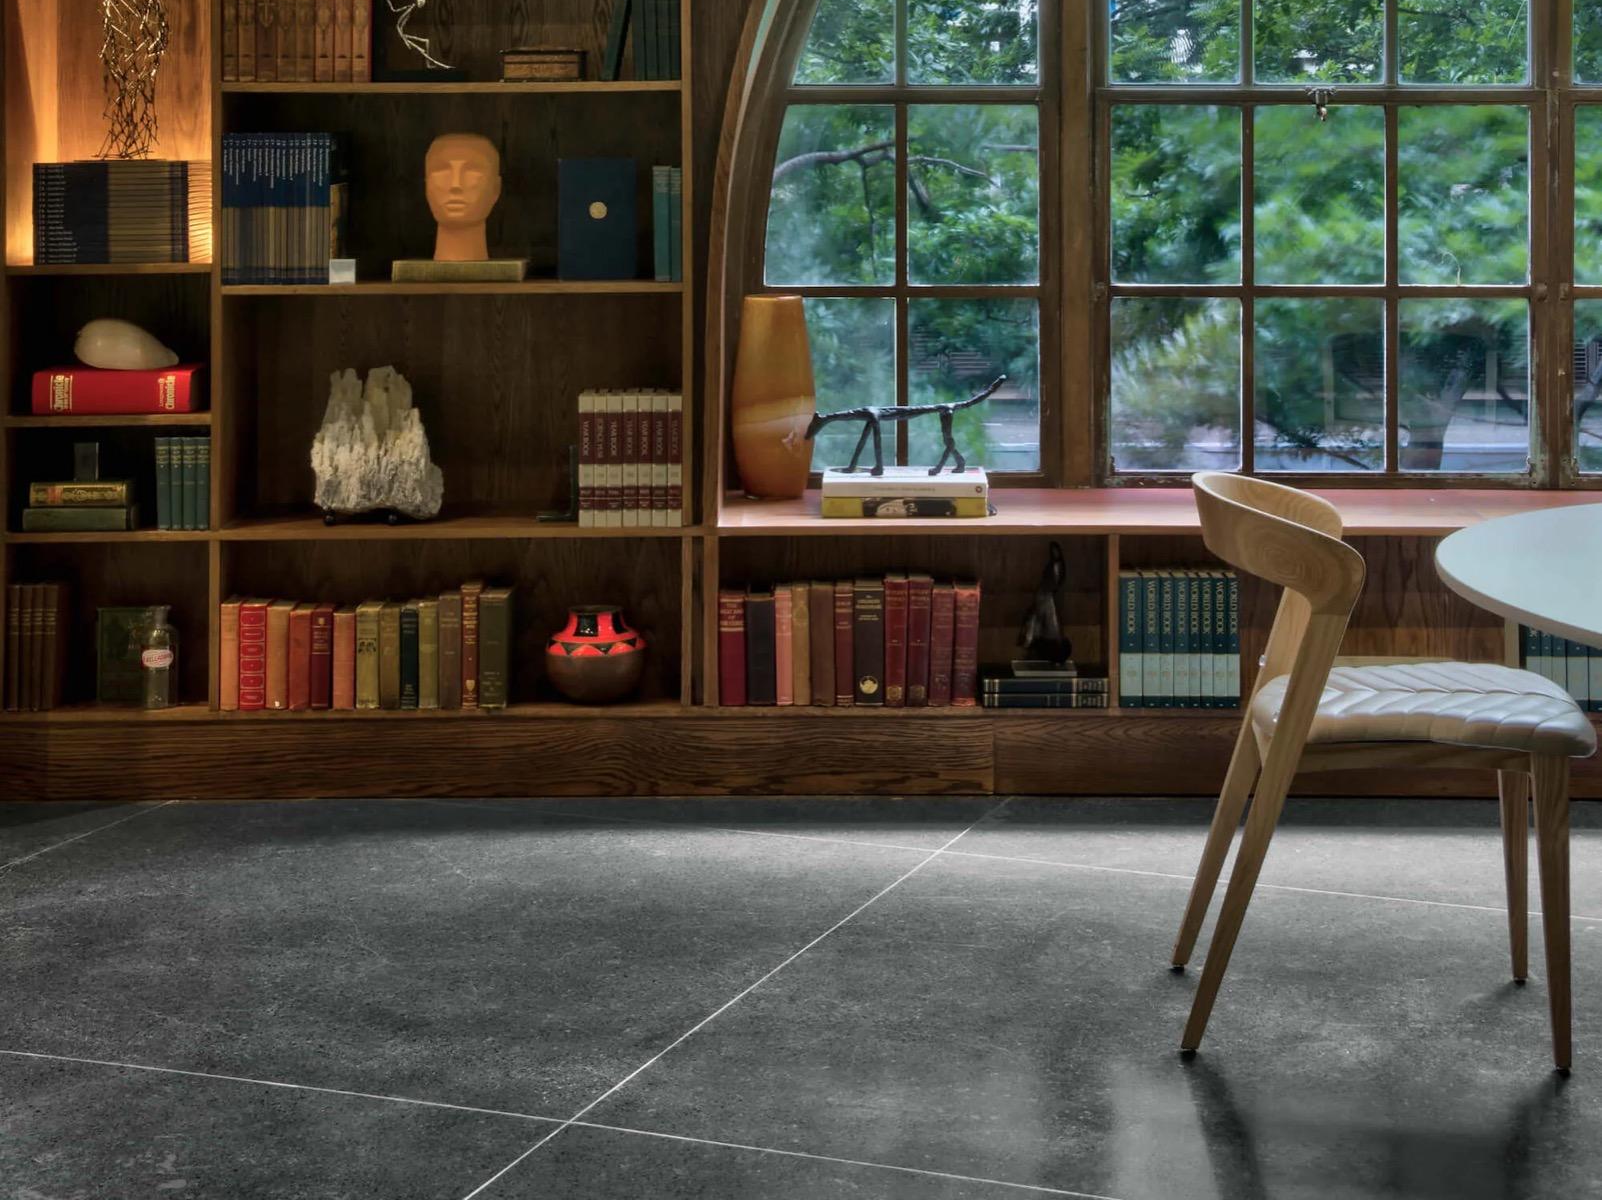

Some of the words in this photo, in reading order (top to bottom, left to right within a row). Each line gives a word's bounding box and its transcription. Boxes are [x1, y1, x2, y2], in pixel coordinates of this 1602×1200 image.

[54, 375, 65, 411] Chronicle
[166, 375, 176, 410] Chronicle
[582, 437, 590, 456] BOOK
[1128, 580, 1136, 610] WORLD
[1148, 580, 1156, 610] WORLD
[1163, 580, 1171, 610] WORLD
[1191, 581, 1199, 610] WORLD
[1203, 581, 1211, 610] WORLD
[1216, 581, 1224, 610] WORLD
[1230, 581, 1238, 610] WORLD
[1128, 611, 1136, 634] BOOK
[1148, 611, 1156, 634] BOOK
[1163, 611, 1171, 634] BOOK
[1191, 612, 1199, 634] BOOK
[1203, 612, 1211, 634] BOOK
[1216, 612, 1224, 634] BOOK
[1230, 612, 1238, 634] BOOK
